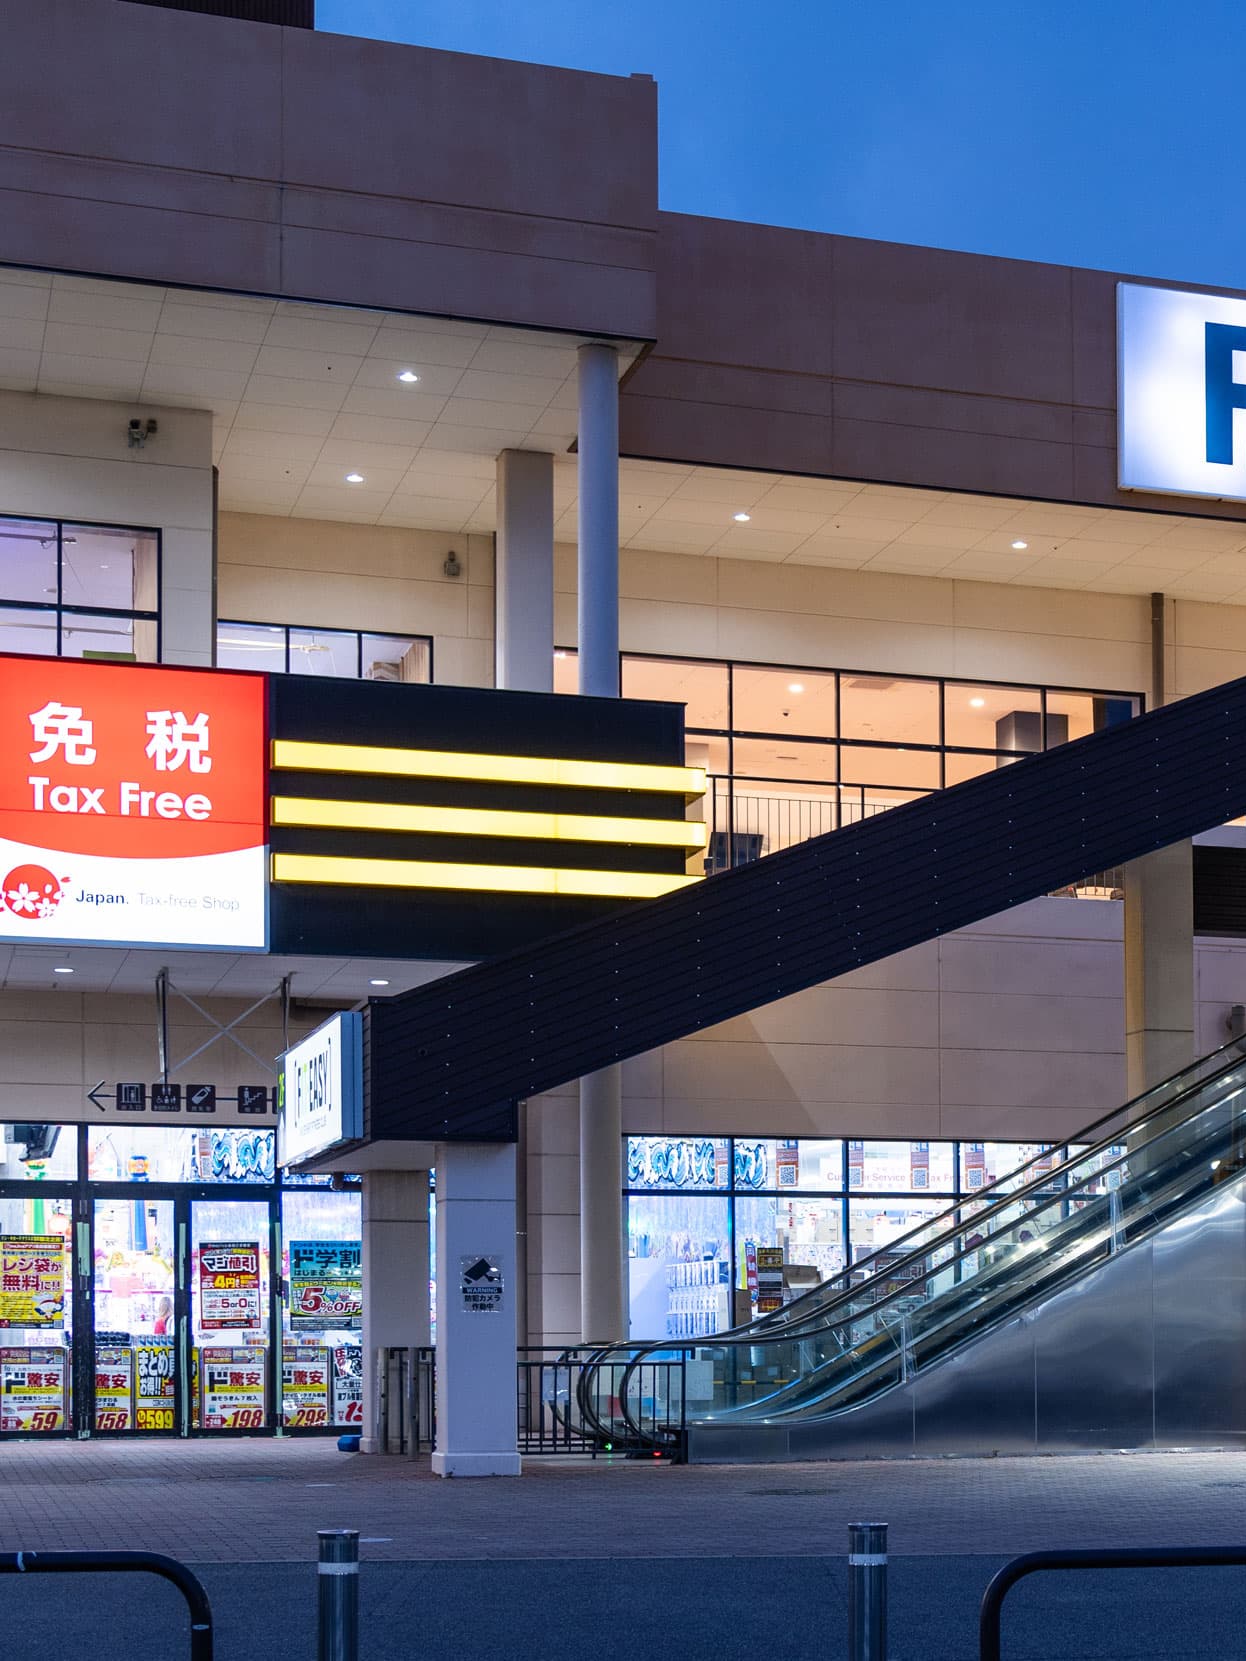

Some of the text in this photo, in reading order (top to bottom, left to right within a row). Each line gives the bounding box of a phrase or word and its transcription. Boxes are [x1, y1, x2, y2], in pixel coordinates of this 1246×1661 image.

[29, 702, 212, 773] 免税
[28, 776, 212, 820] Tax Free
[138, 892, 197, 908] Tax-free
[202, 896, 240, 912] Shop
[3, 1258, 61, 1272] レジ袋が
[232, 1409, 263, 1428] 198
